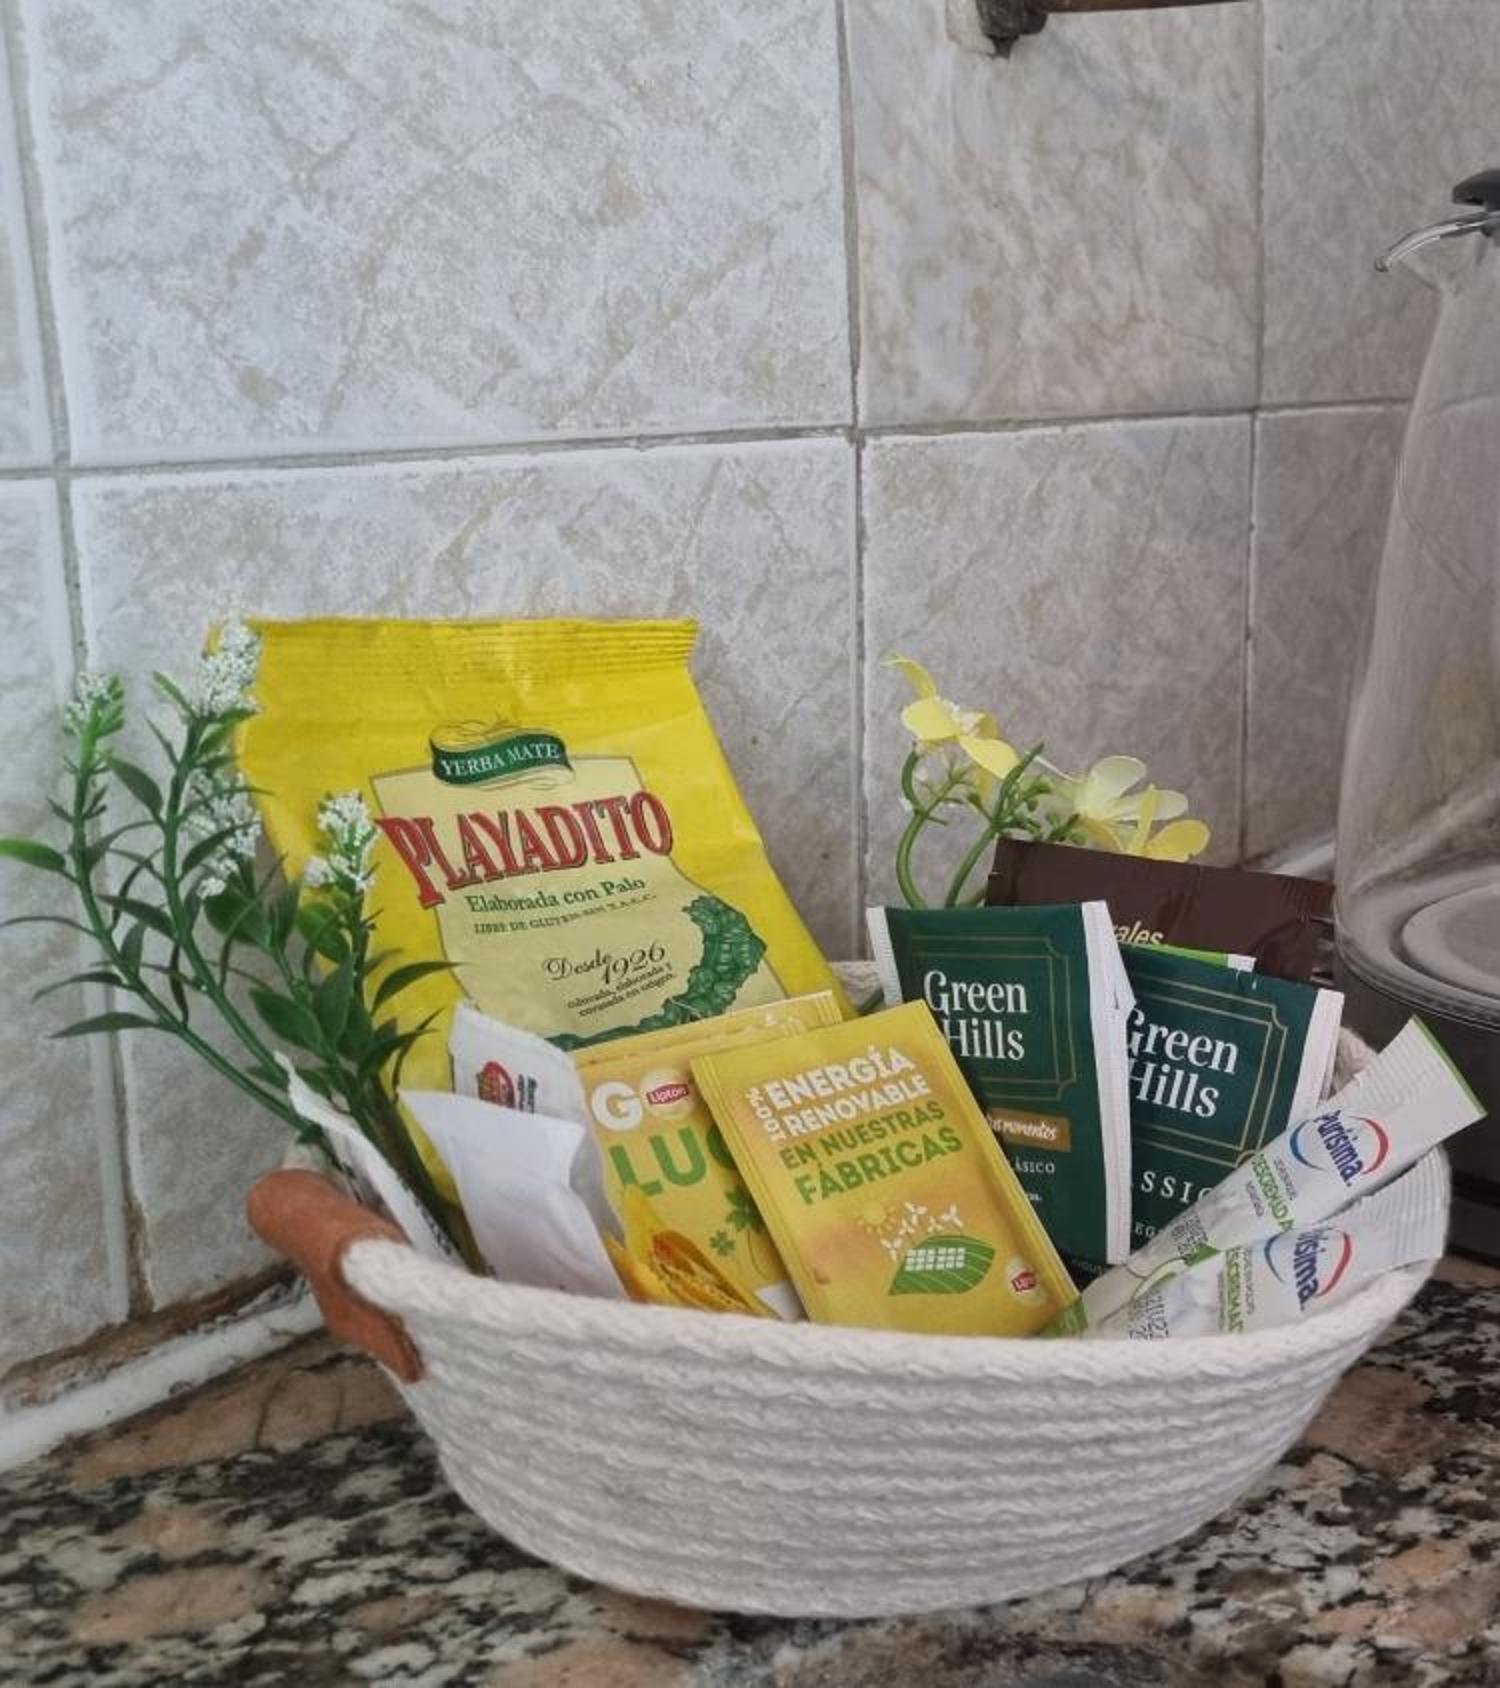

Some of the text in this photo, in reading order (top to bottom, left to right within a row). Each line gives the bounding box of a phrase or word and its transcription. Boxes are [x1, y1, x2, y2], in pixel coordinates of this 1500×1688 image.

[440, 743, 561, 777] YERBA MATE
[373, 791, 674, 910] PLAYADITO
[464, 877, 647, 914] Elaborada con Palo
[541, 938, 666, 985] Desde 1926
[923, 969, 1029, 1016] Green
[941, 1016, 1025, 1061] Hills
[766, 1044, 917, 1110] ENERGÍA
[782, 1073, 932, 1137] RENOVABLE
[1128, 1057, 1220, 1118] Hills
[779, 1100, 946, 1171] EN NUESTRAS
[793, 1126, 964, 1205] FÁBRICAS
